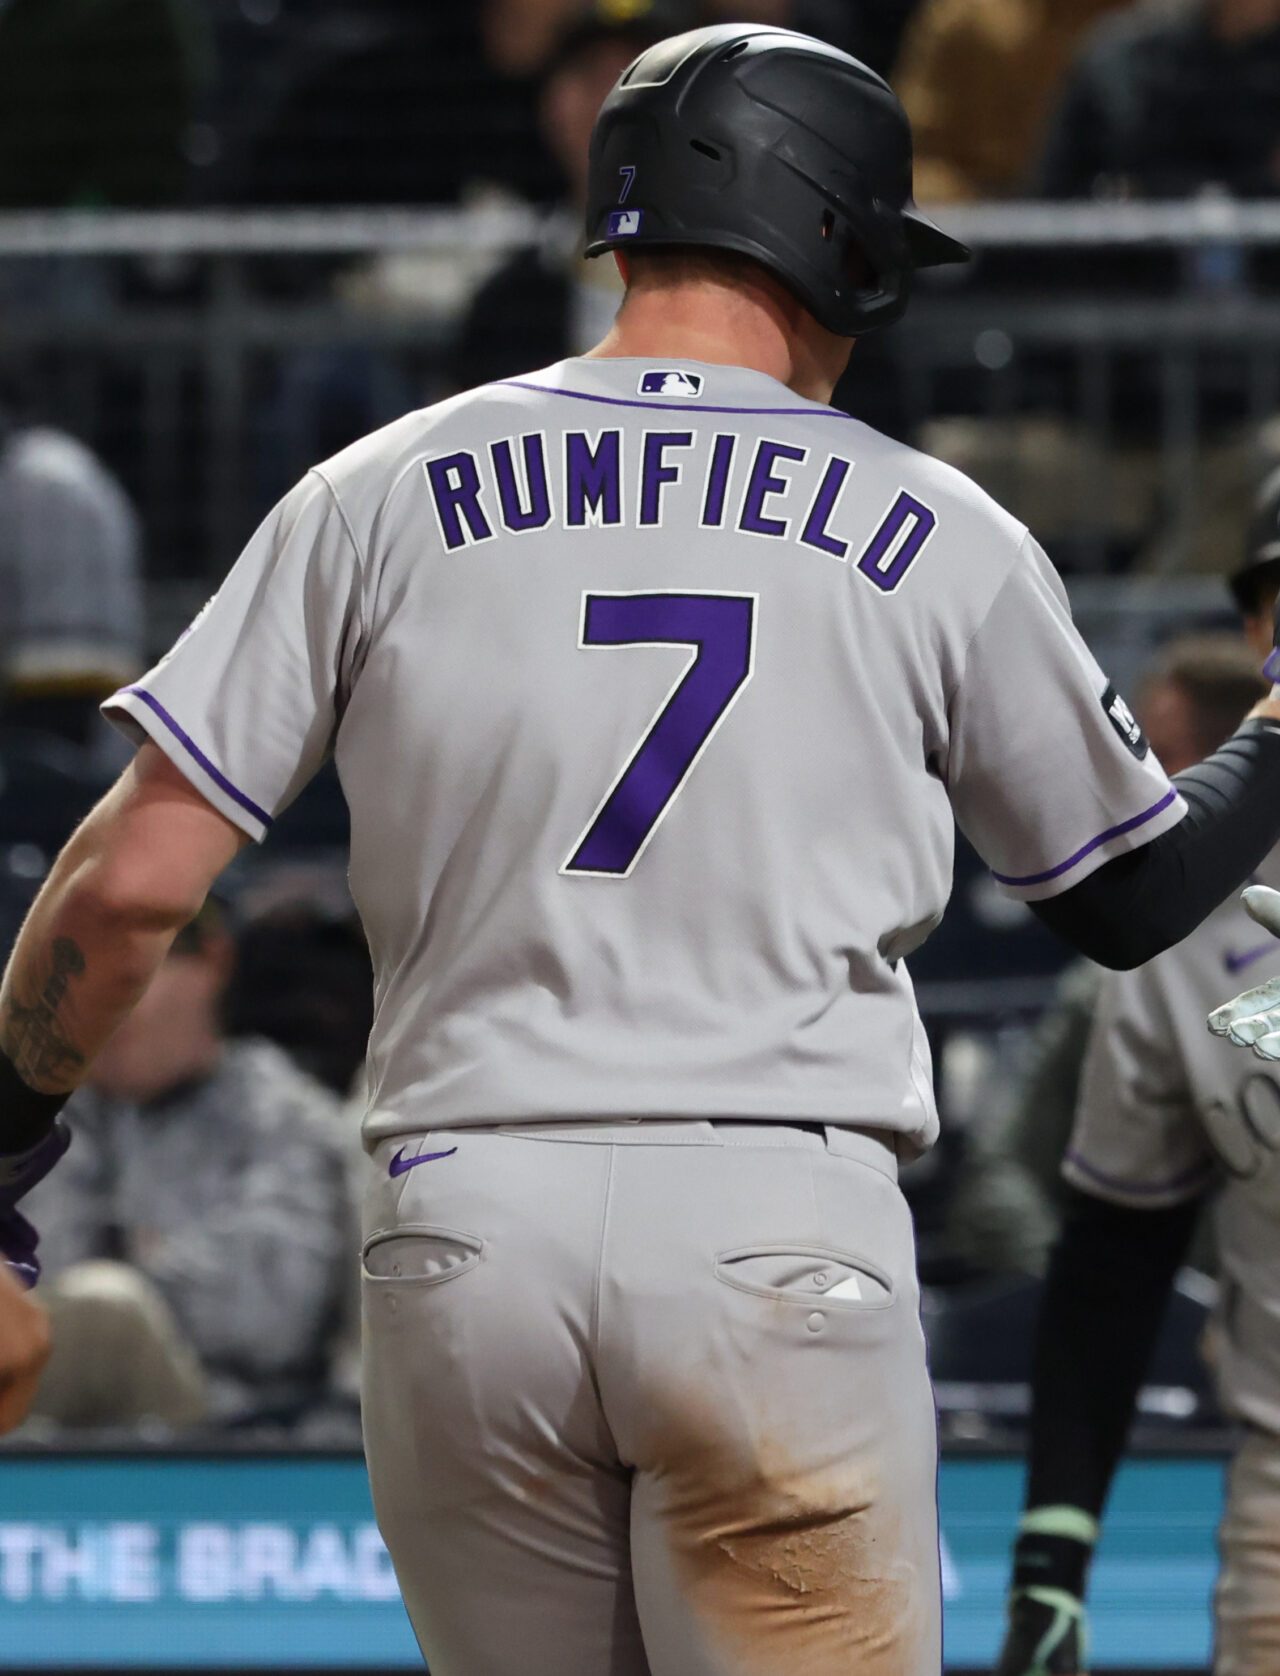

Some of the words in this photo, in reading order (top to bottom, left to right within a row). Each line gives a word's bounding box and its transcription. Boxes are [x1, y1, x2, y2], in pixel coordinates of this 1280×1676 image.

[618, 165, 636, 204] 7
[422, 427, 939, 595] RUMFIELD
[557, 588, 760, 879] 7
[0, 1521, 159, 1602] THE
